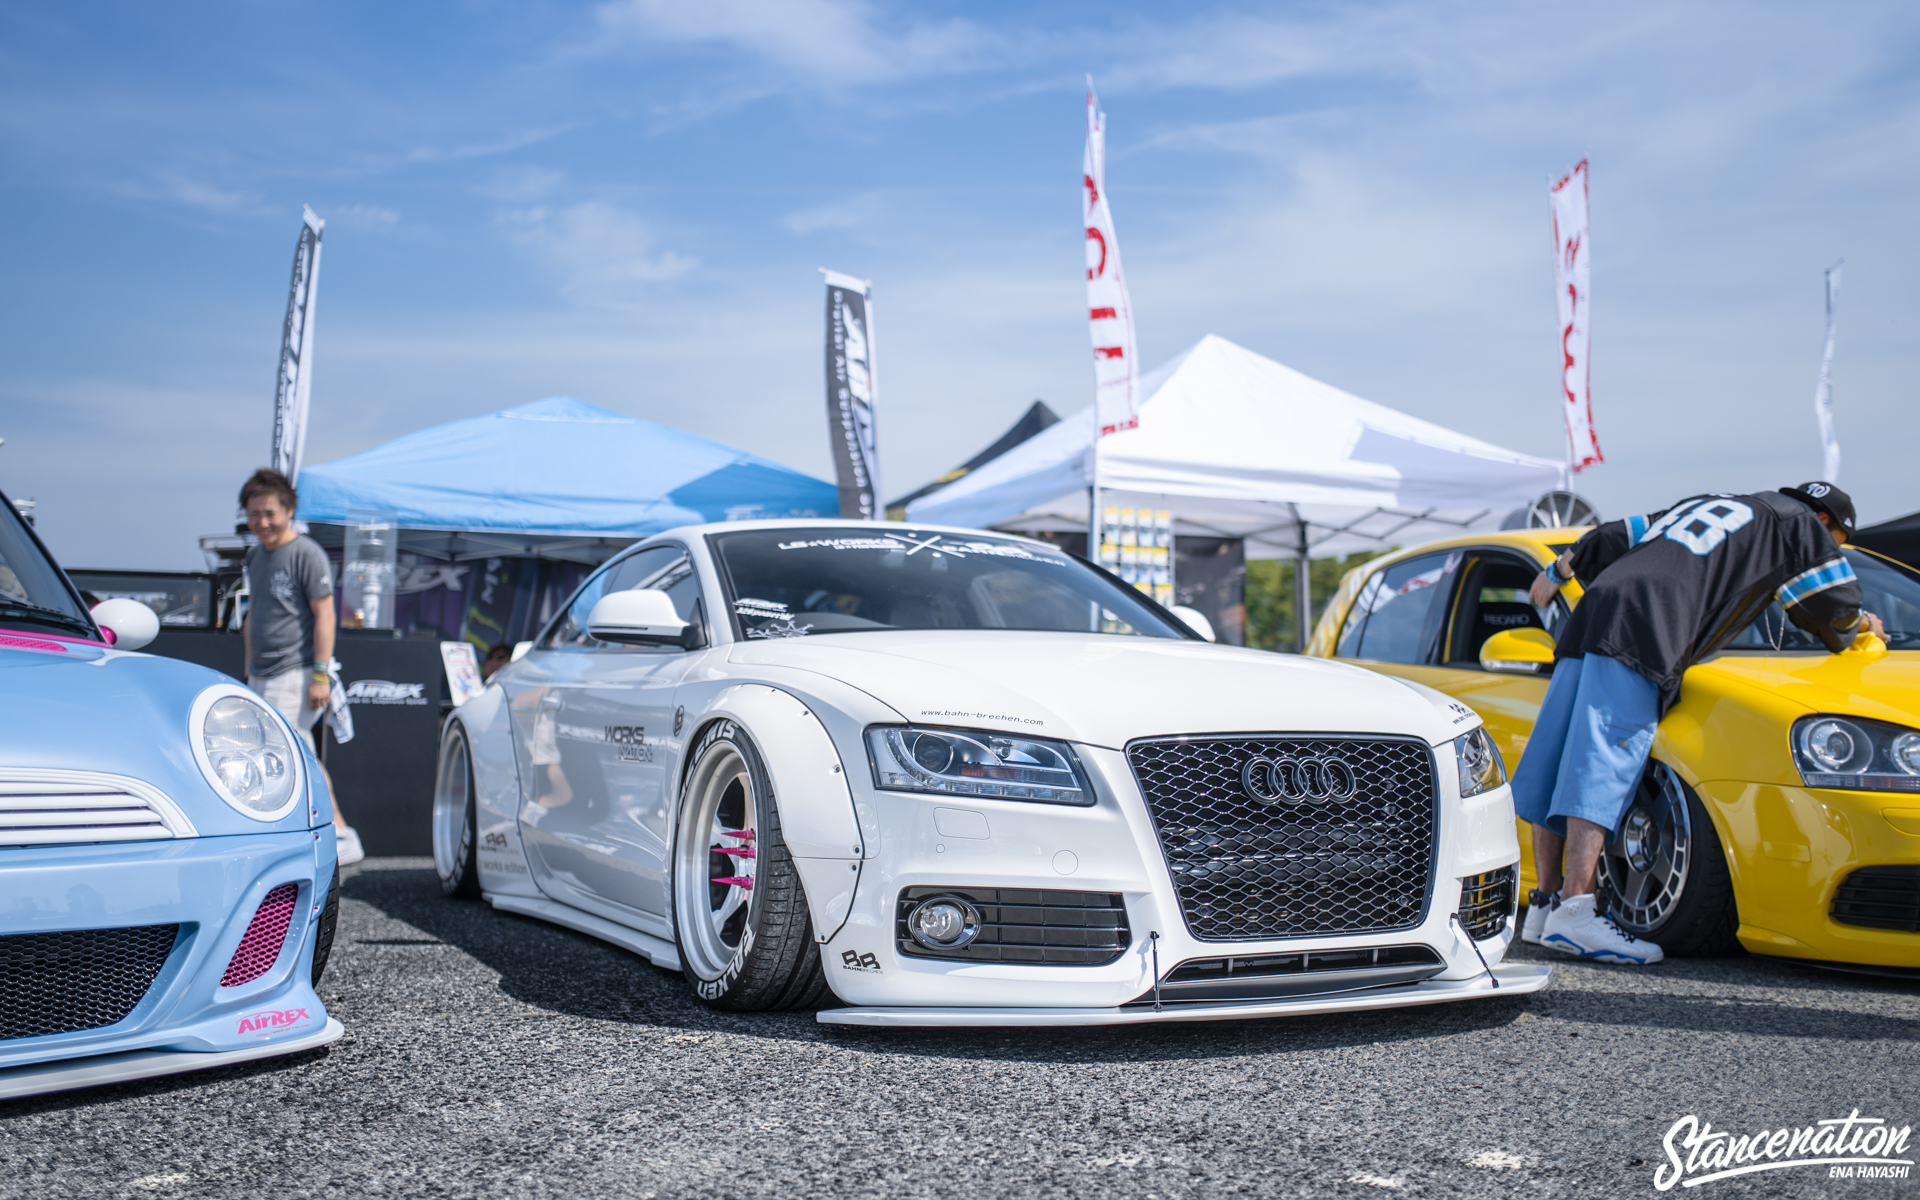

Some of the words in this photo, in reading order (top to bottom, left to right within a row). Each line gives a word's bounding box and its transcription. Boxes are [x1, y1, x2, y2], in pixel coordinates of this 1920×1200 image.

[1483, 613, 1530, 626] RECARO
[920, 709, 1045, 726] www.bahn-brechen.com
[604, 725, 645, 744] WORKS
[841, 949, 881, 970] BB
